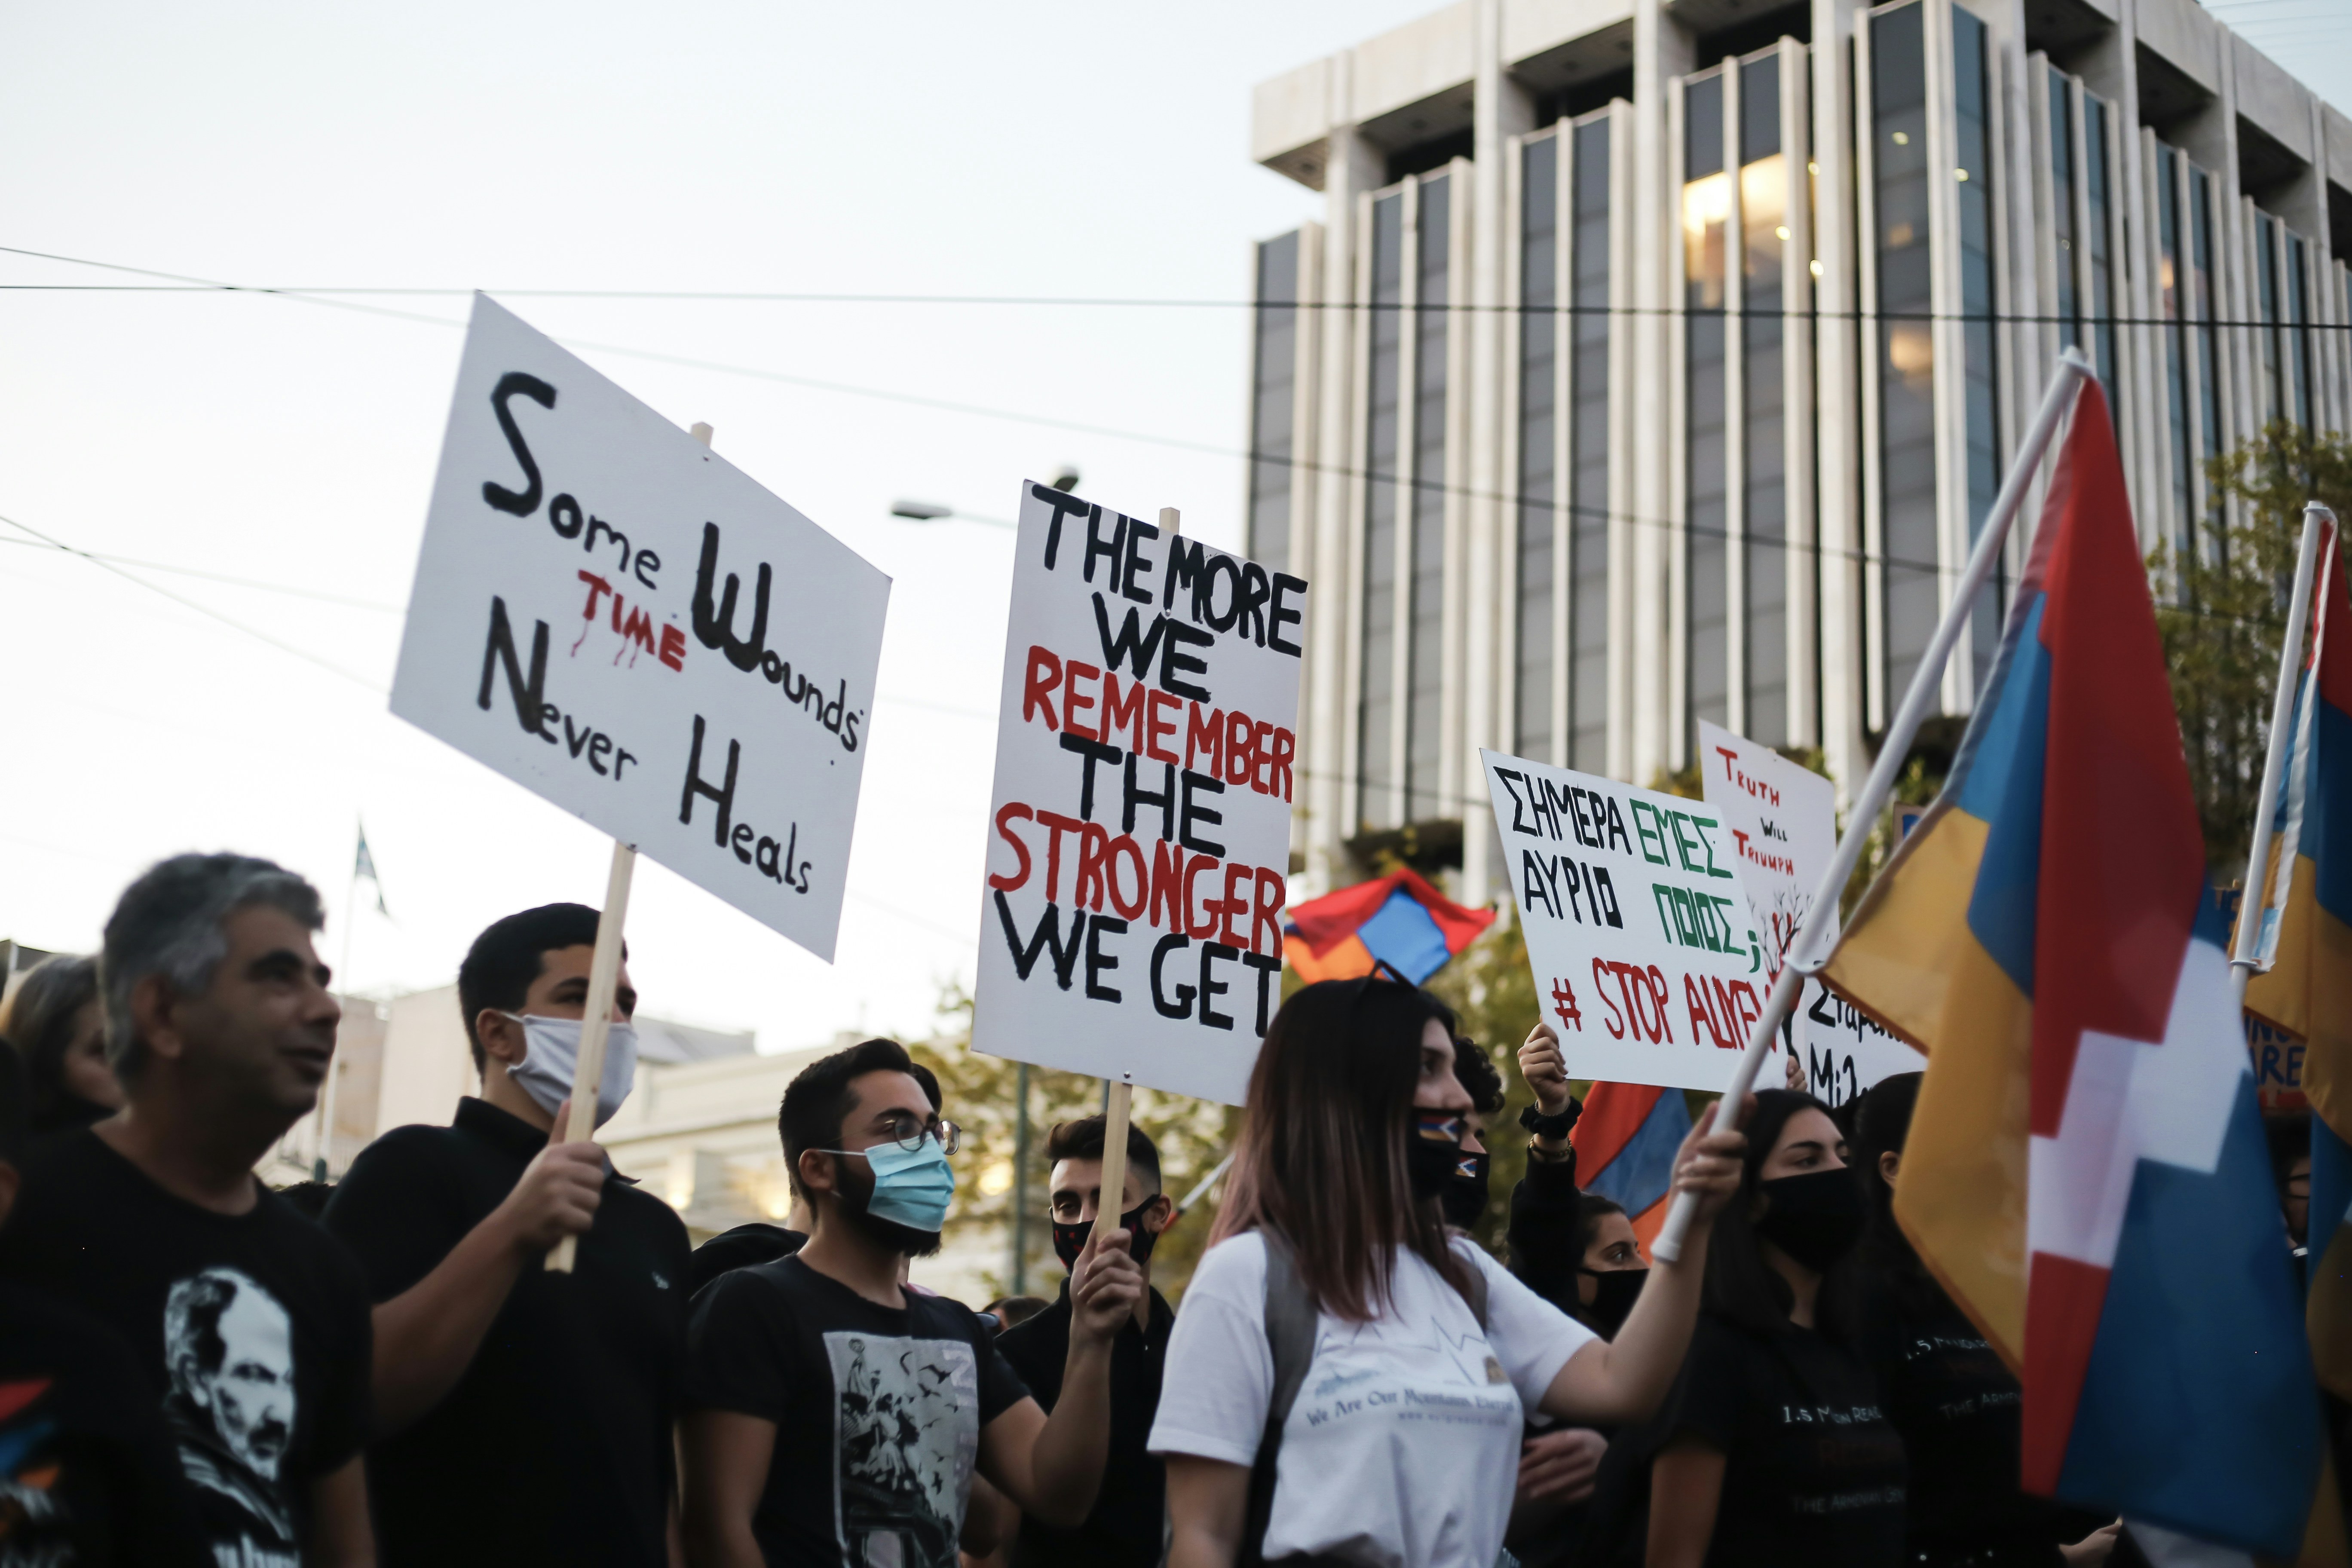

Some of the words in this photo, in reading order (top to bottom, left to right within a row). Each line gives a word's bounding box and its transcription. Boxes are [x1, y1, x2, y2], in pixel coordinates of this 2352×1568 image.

[481, 371, 661, 590] Some
[690, 521, 858, 752] Wounds
[576, 568, 687, 673] TIME
[1032, 484, 1159, 605] THE
[1163, 533, 1308, 658] MORE
[1091, 591, 1215, 704] WE
[477, 594, 638, 781] Never
[678, 714, 812, 895] Heals
[1022, 644, 1295, 804] REMEMBER
[1059, 731, 1226, 858] THE
[1493, 766, 1632, 855] ΣΗΜΕΡΑ
[988, 802, 1286, 960] STRONGER
[1522, 849, 1623, 930] ΑΥΡΙΟ
[993, 888, 1129, 1004] WE
[1150, 933, 1282, 1039] GET
[1592, 956, 1674, 1045] STOP
[1307, 1407, 1329, 1427] We
[1335, 1399, 1363, 1418] Are
[1782, 1406, 1813, 1424] 1.5
